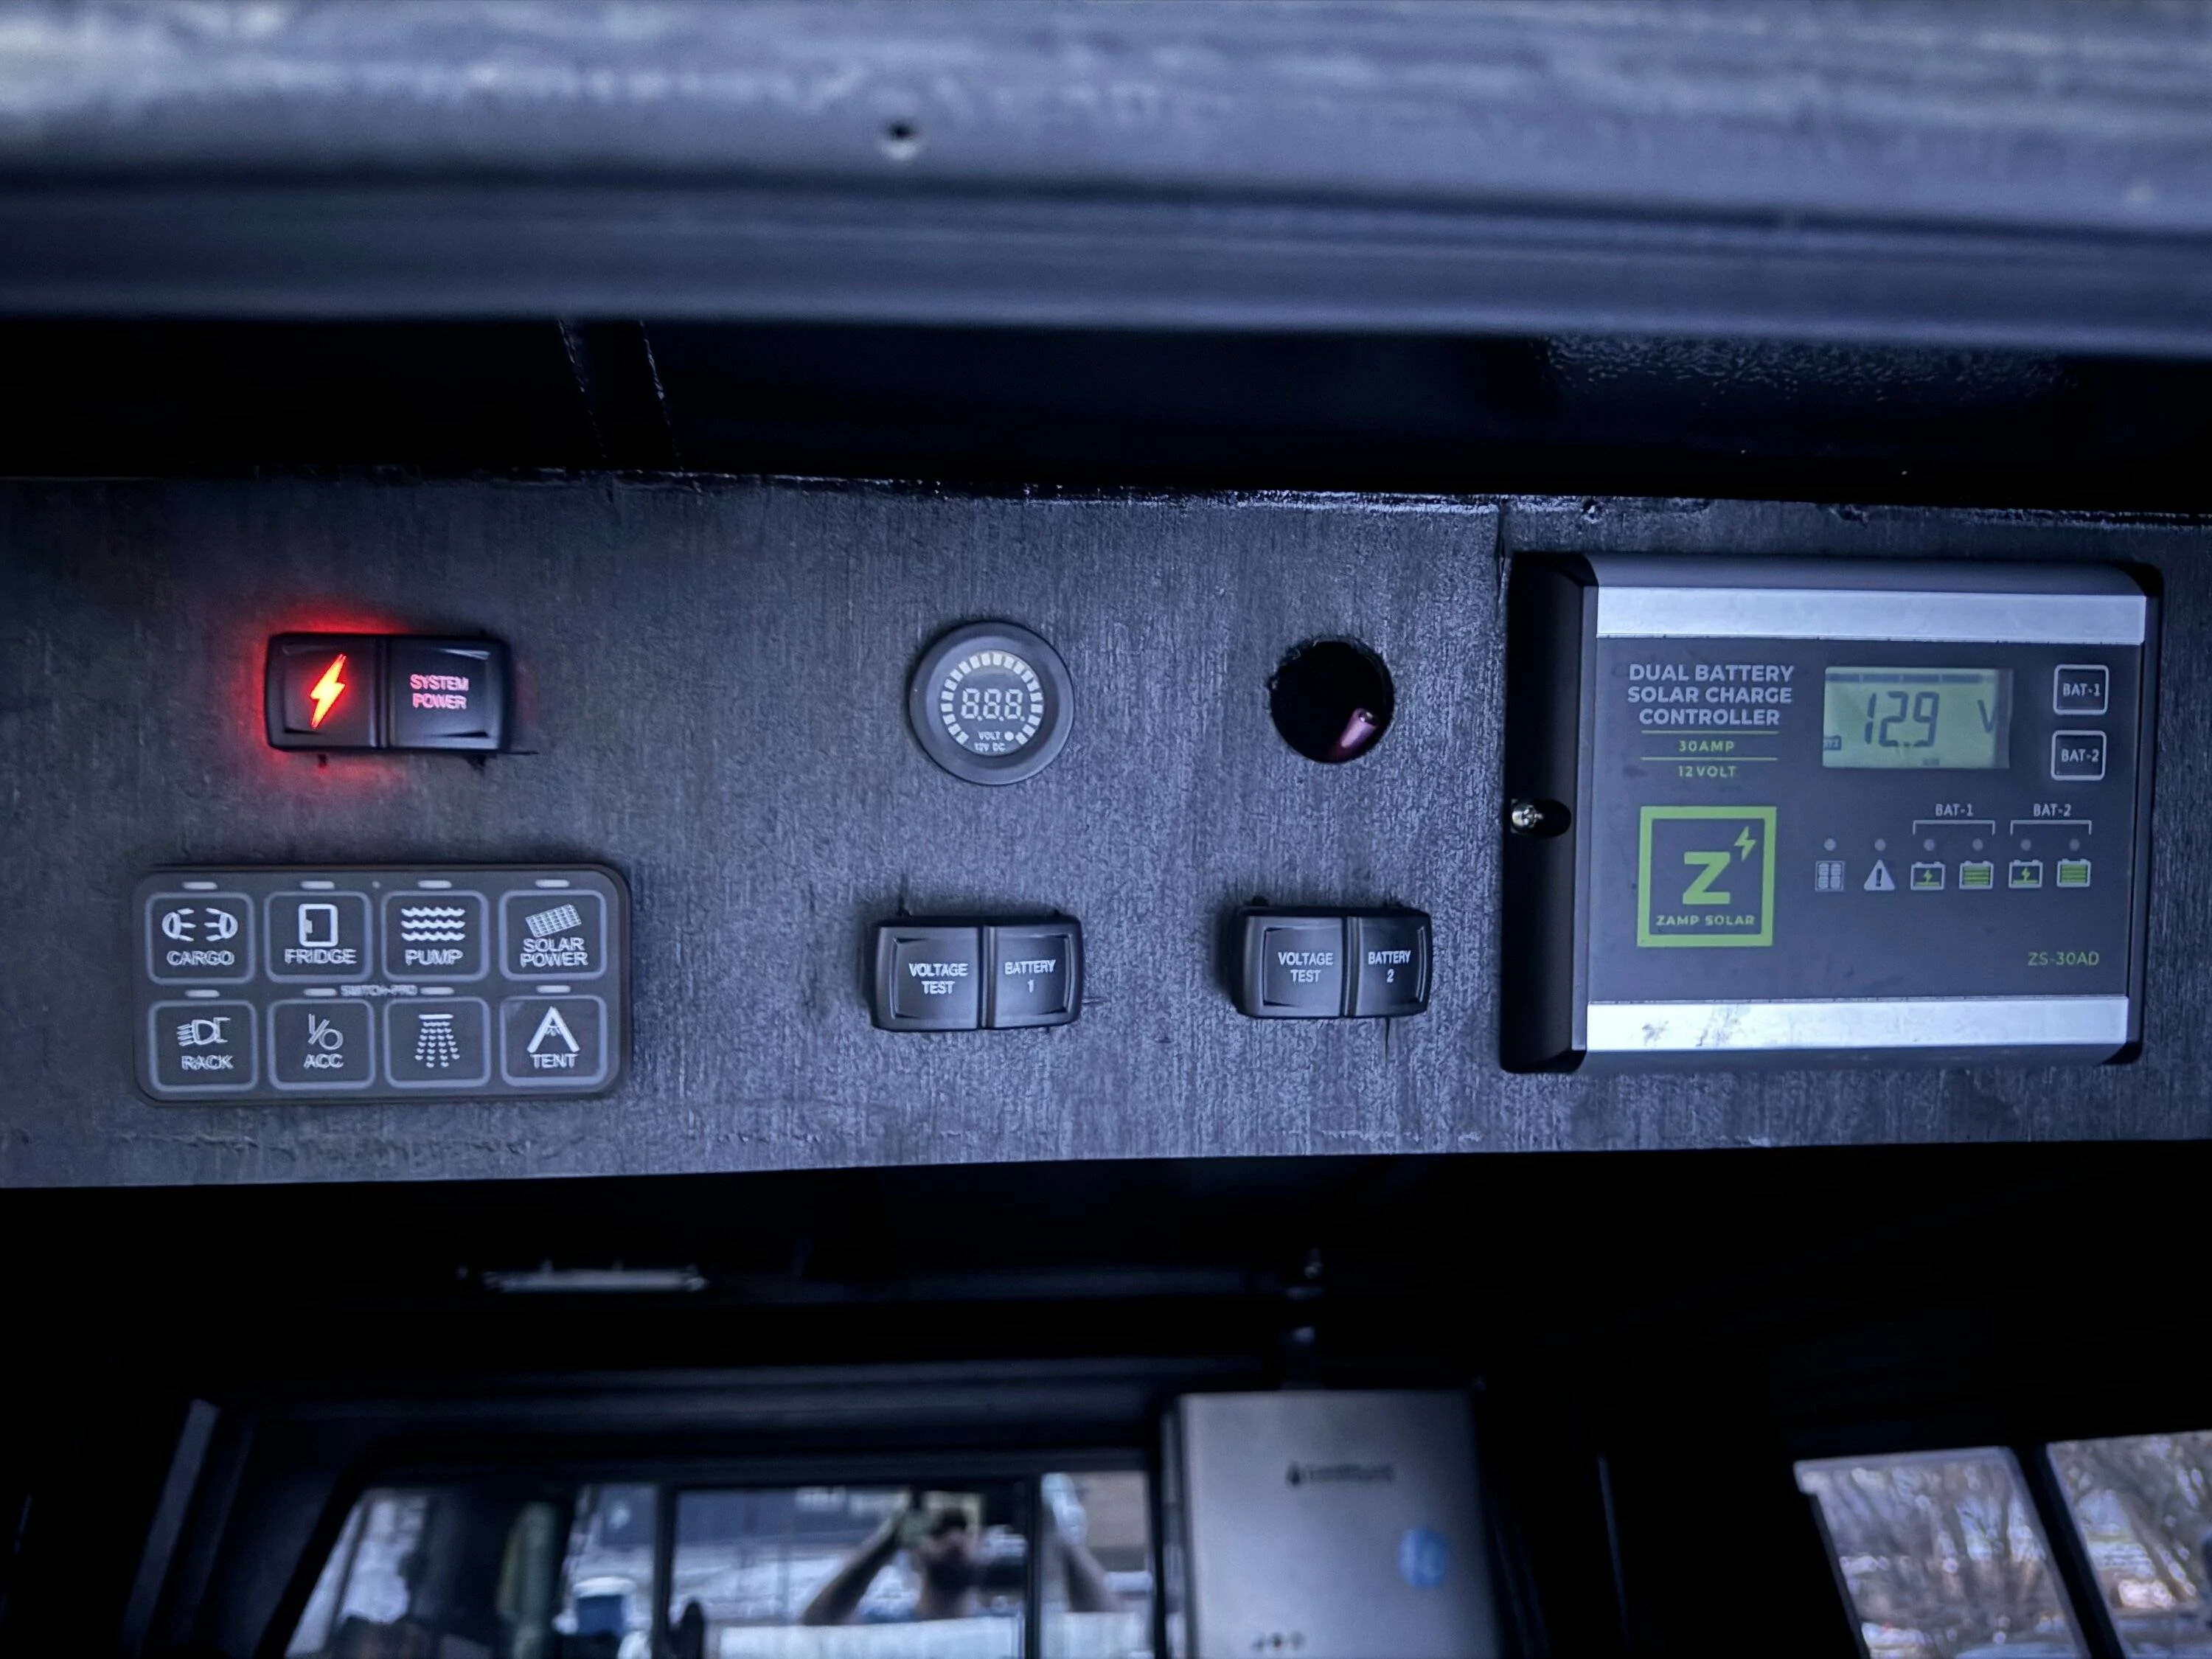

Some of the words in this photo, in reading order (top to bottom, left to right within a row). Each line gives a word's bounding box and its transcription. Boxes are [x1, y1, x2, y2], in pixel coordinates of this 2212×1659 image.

[1629, 664, 1689, 681] DUAL
[1695, 664, 1795, 682] BATTERY
[410, 674, 469, 691] SYSTEM
[2062, 683, 2101, 697] BAT-1
[412, 693, 467, 709] POWER
[1627, 686, 1699, 703] SOLAR
[1705, 687, 1792, 703] CHARGE
[1638, 708, 1781, 726] CONTROLLER
[2061, 748, 2099, 763] BAT-2
[1935, 804, 1974, 817] BAT-1
[2033, 804, 2072, 817] BAT-2
[1656, 915, 1700, 926] ZAMP
[1705, 915, 1756, 926] SOLAR
[522, 937, 585, 953] SOLAR
[166, 950, 235, 967] CARGO
[284, 948, 357, 965] FRIDGE
[405, 948, 463, 965] PUMP
[520, 950, 588, 968] POWER
[1278, 952, 1334, 966] VOLTAGE
[1368, 950, 1411, 965] BATTERY
[2028, 952, 2100, 967] ZS-30AD
[908, 963, 969, 978] VOLTAGE
[1004, 959, 1056, 975] BATTERY
[1290, 970, 1321, 983] TEST
[1387, 969, 1394, 984] 2
[922, 981, 956, 995] TEST
[1027, 979, 1034, 993] 1
[181, 1054, 233, 1071] RACK
[304, 1054, 344, 1069] ACC
[530, 1054, 577, 1068] TENT
